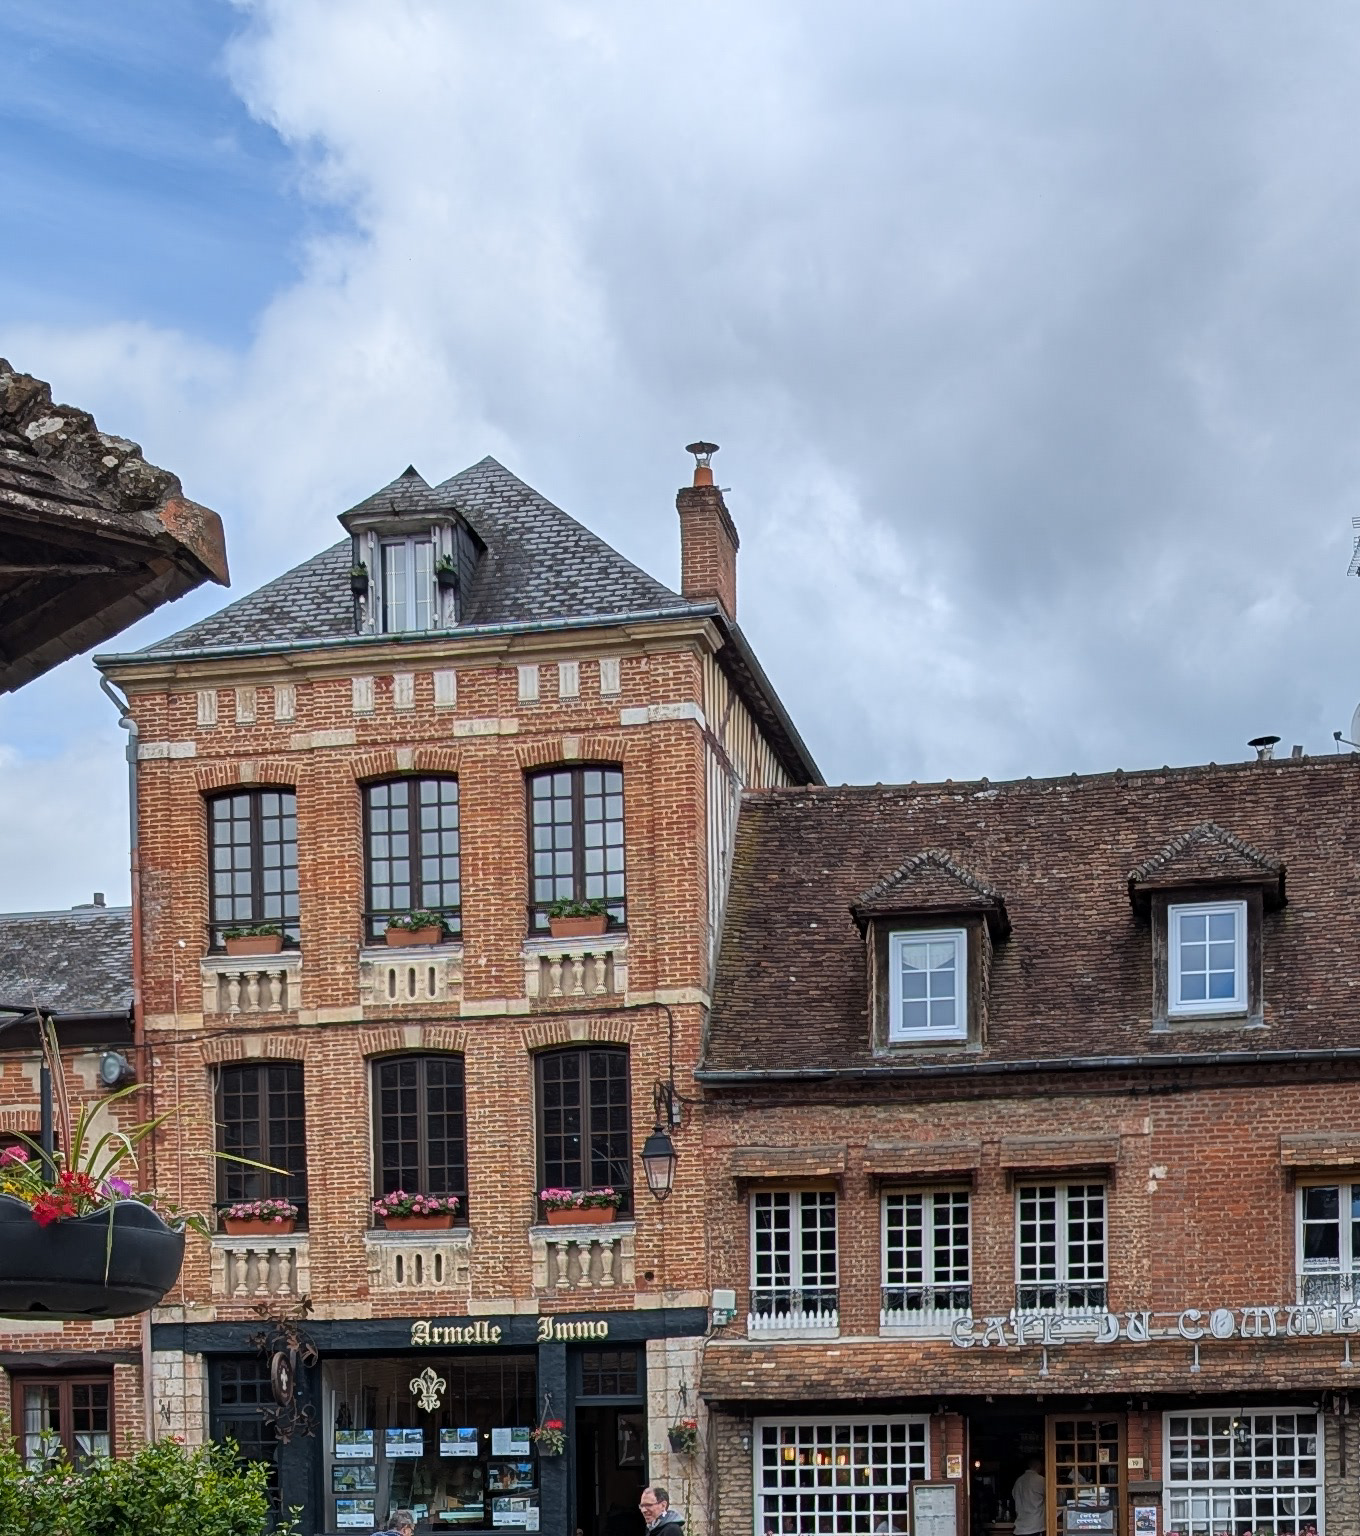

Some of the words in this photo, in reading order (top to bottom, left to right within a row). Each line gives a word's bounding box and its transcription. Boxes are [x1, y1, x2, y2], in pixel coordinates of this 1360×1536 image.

[410, 1320, 502, 1346] Armelle
[536, 1316, 609, 1342] Immo
[1093, 1310, 1153, 1343] DU
